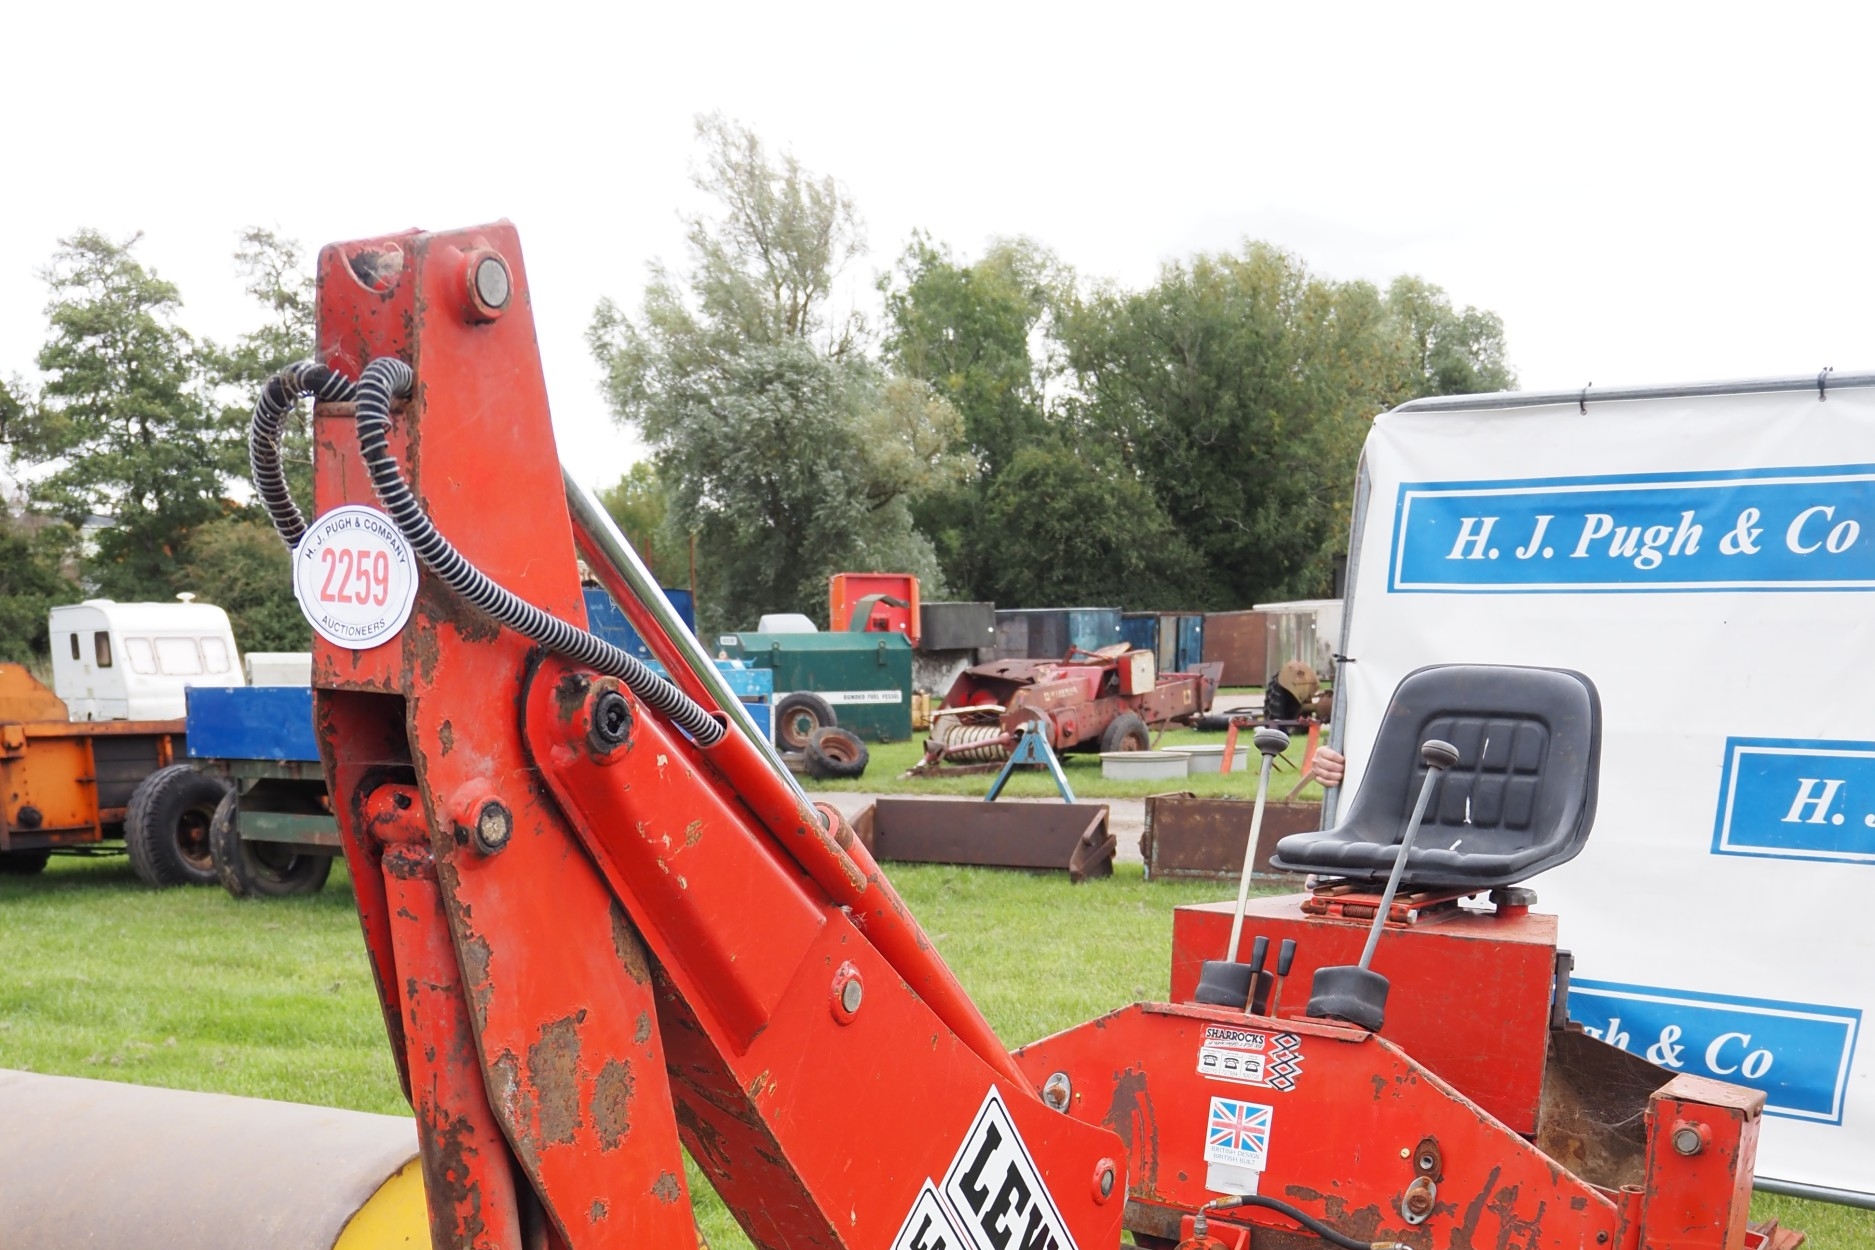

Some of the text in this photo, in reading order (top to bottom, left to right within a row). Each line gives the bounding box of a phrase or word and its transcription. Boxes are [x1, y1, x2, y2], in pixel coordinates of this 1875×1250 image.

[305, 516, 406, 564] H. J. PUGH & COMPANY
[1445, 505, 1861, 570] H. J. Pugh & Co
[320, 547, 390, 607] 2259
[321, 615, 386, 636] AUCTIONEERS
[1780, 778, 1846, 826] H.
[1206, 1028, 1264, 1044] SHARROCKS
[1646, 1025, 1685, 1068] &
[1705, 1032, 1774, 1079] Co
[1211, 1145, 1260, 1160] BRITISH DESIGN
[1213, 1153, 1255, 1165] BRITISH BUILT
